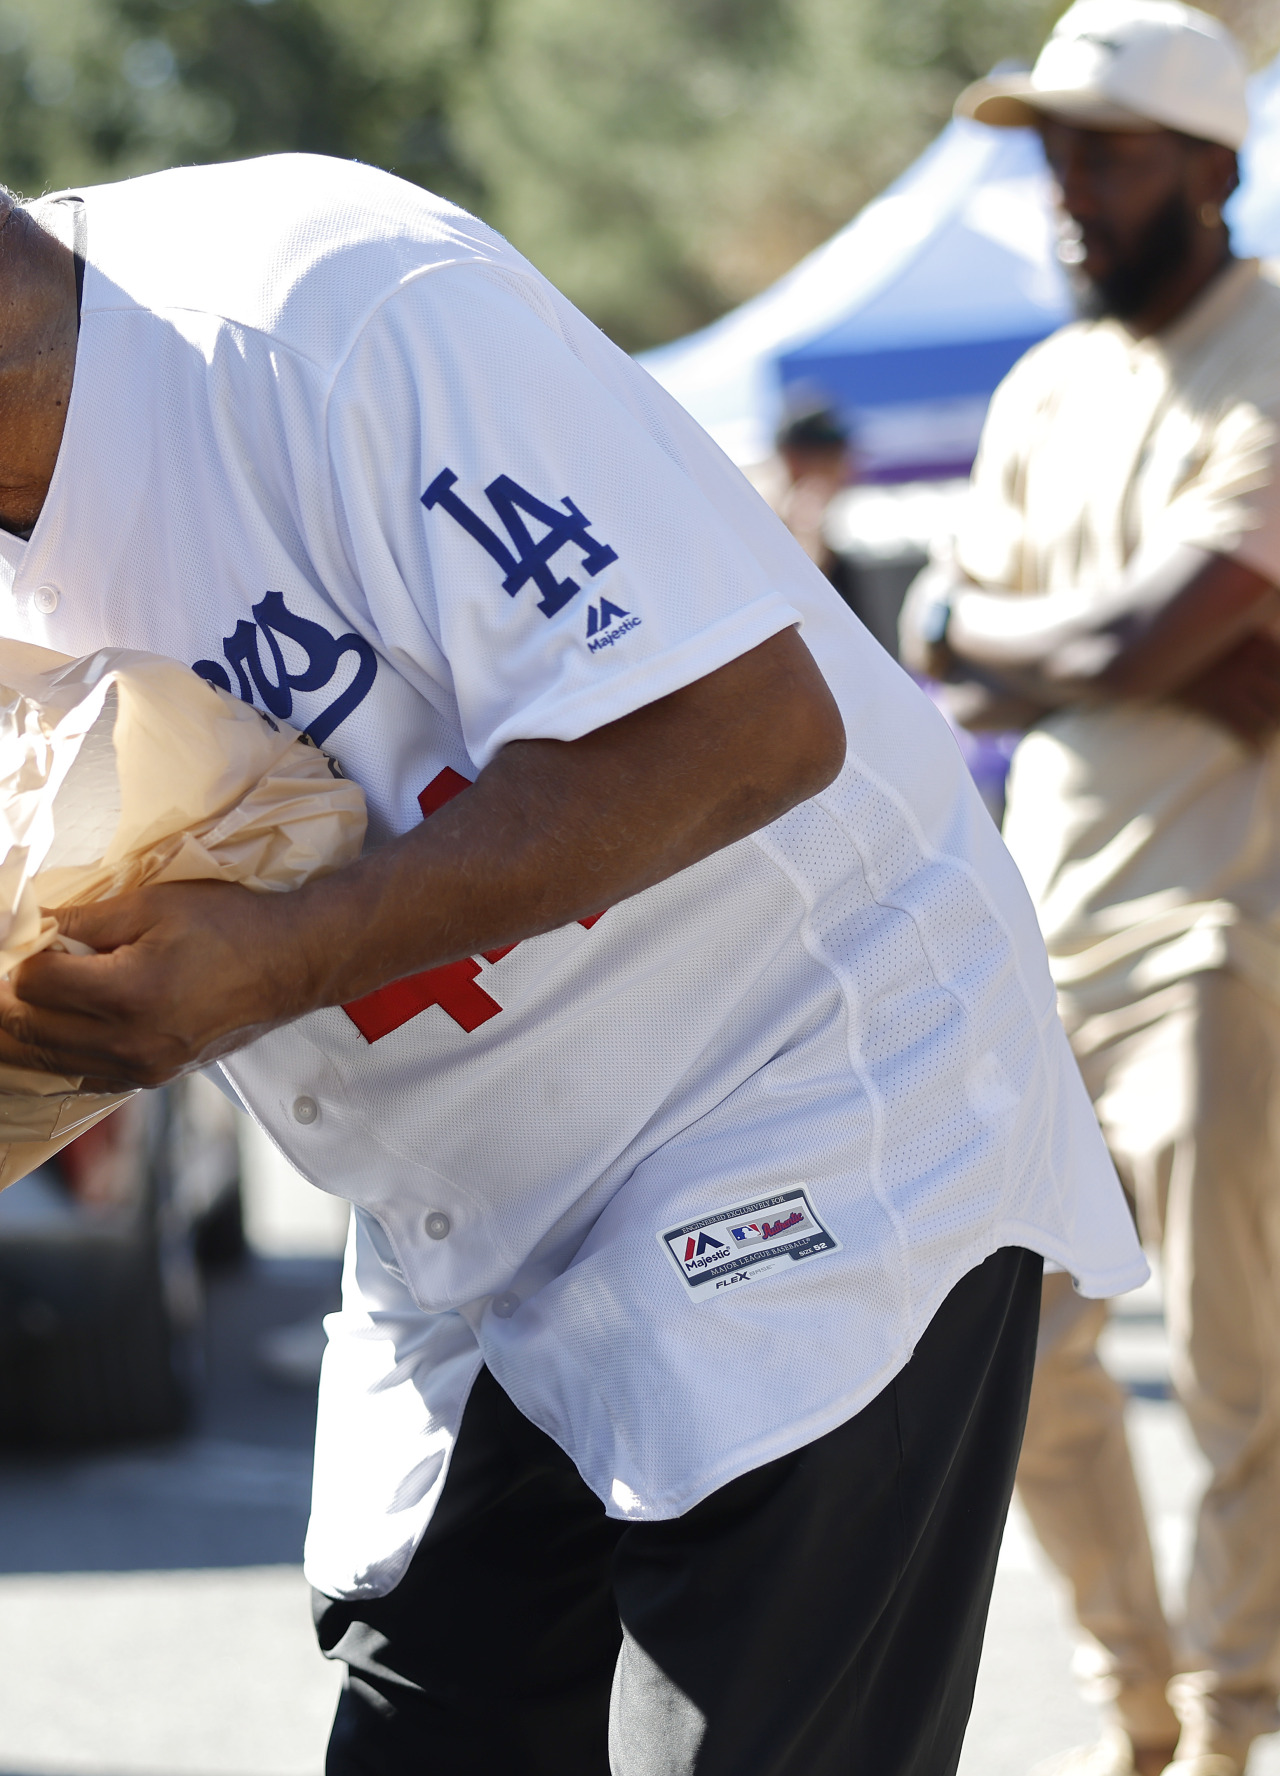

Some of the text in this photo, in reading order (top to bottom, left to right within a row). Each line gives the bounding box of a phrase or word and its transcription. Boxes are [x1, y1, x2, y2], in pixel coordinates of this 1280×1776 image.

[420, 467, 619, 619] LA
[587, 617, 642, 653] Majestic
[682, 1196, 786, 1234] ENGINEERED EXCLUSIVELY FOR
[762, 1212, 804, 1240] Authentic
[685, 1249, 731, 1271] Majestic
[710, 1239, 809, 1276] MAJOR LEAGUE BASEBALL
[798, 1242, 828, 1257] SIZE 52
